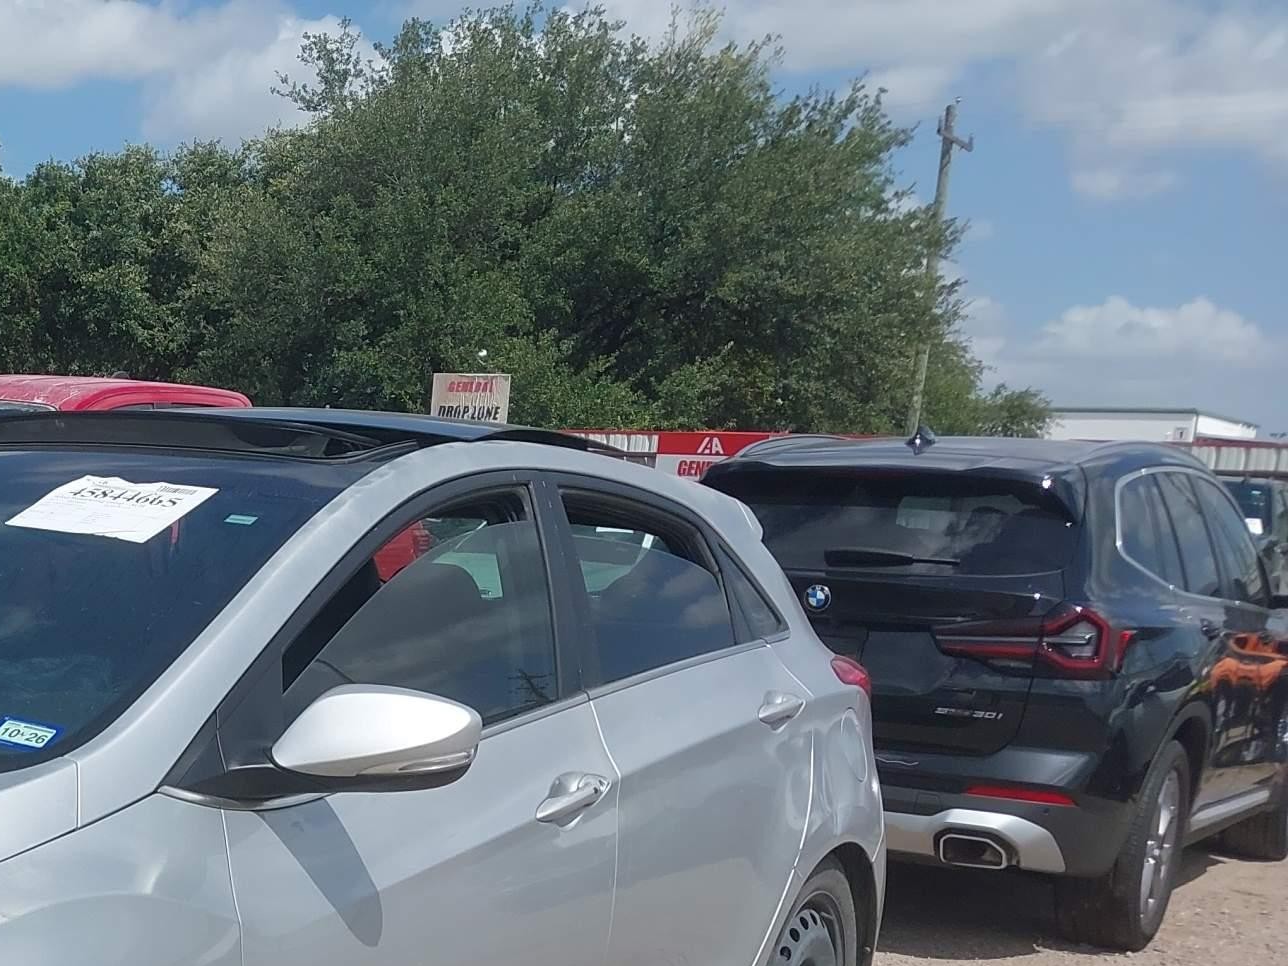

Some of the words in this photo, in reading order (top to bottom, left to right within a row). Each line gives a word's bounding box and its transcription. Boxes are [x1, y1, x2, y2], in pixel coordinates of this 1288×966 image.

[438, 406, 470, 419] DROP
[471, 406, 500, 420] ZONE
[678, 460, 713, 477] GEN
[69, 487, 182, 507] 45844665
